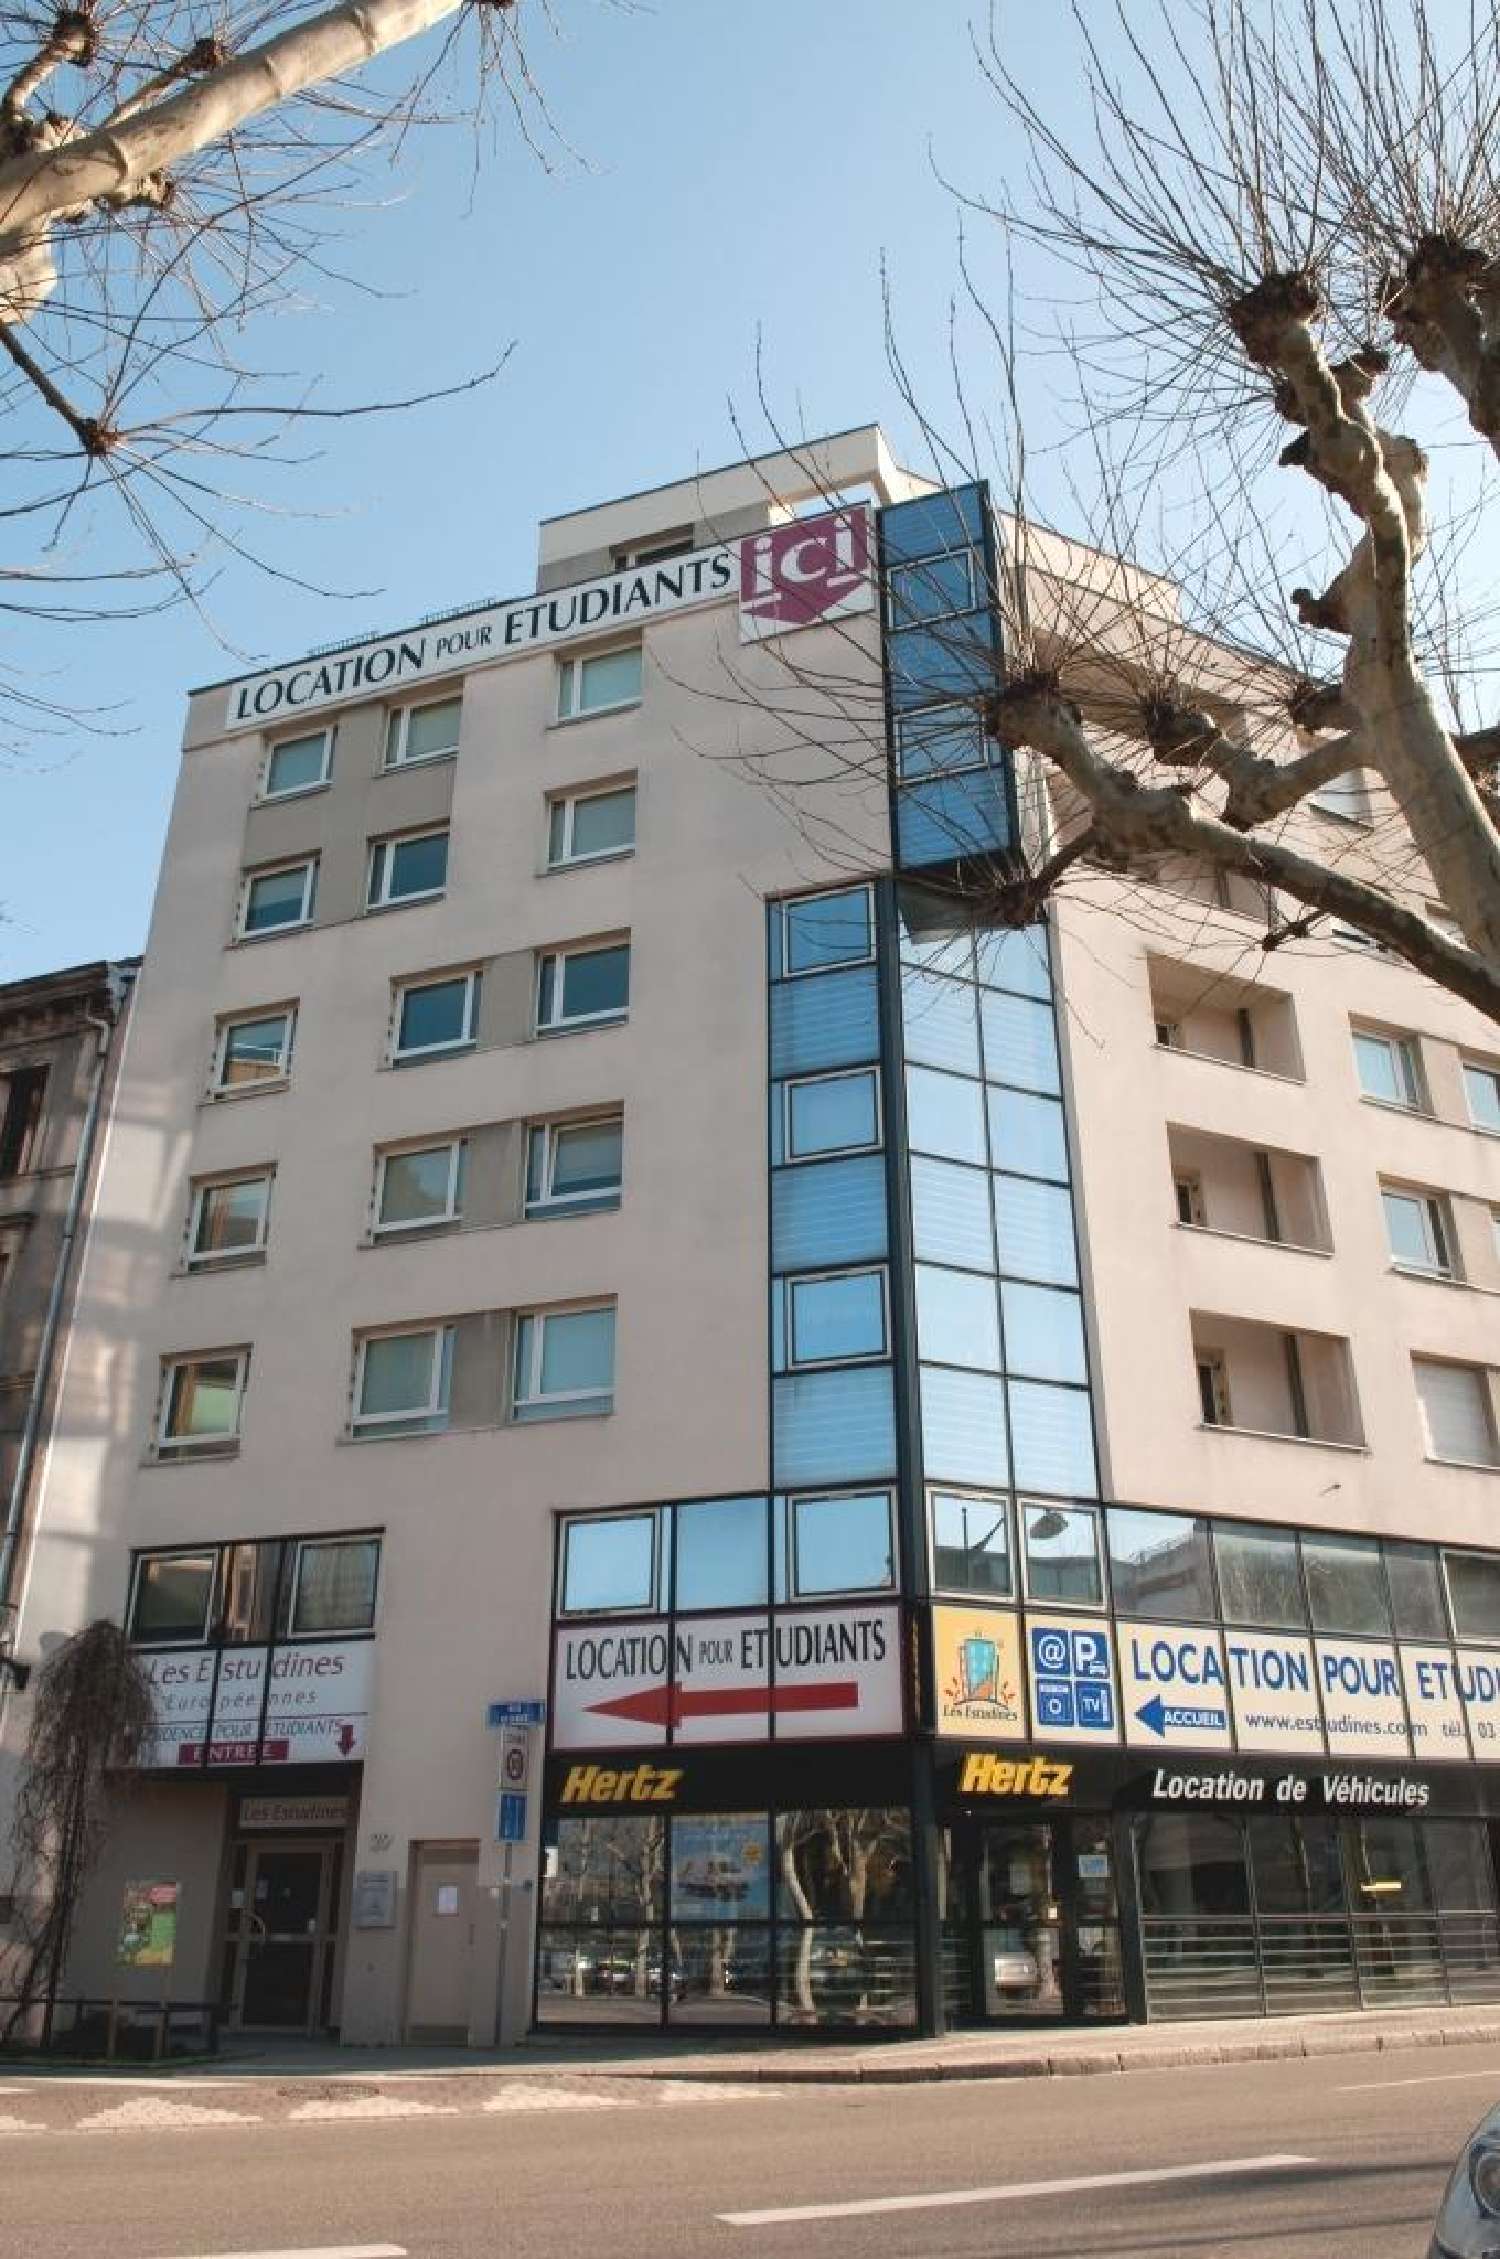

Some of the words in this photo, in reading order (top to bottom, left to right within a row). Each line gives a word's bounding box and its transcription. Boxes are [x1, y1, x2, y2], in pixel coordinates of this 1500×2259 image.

[235, 637, 426, 719] LOCATION
[435, 625, 494, 661] POUR
[503, 552, 731, 645] ETUDIANTS
[148, 1658, 190, 1684] Les
[196, 1651, 345, 1682] Estudines
[566, 1634, 693, 1680] LOCATION
[699, 1639, 734, 1665] POUR
[740, 1619, 887, 1669] ETUDIANTS
[1132, 1639, 1309, 1693] LOCATION
[1323, 1655, 1401, 1697] POUR
[1164, 1710, 1223, 1726] ACCUEIL
[1245, 1713, 1428, 1738] www.estudines.com
[560, 1765, 685, 1802] Hertz
[960, 1752, 1075, 1796] Hertz
[1152, 1768, 1265, 1801] Location
[1276, 1774, 1307, 1802] de
[1323, 1774, 1430, 1807] Véhicules
